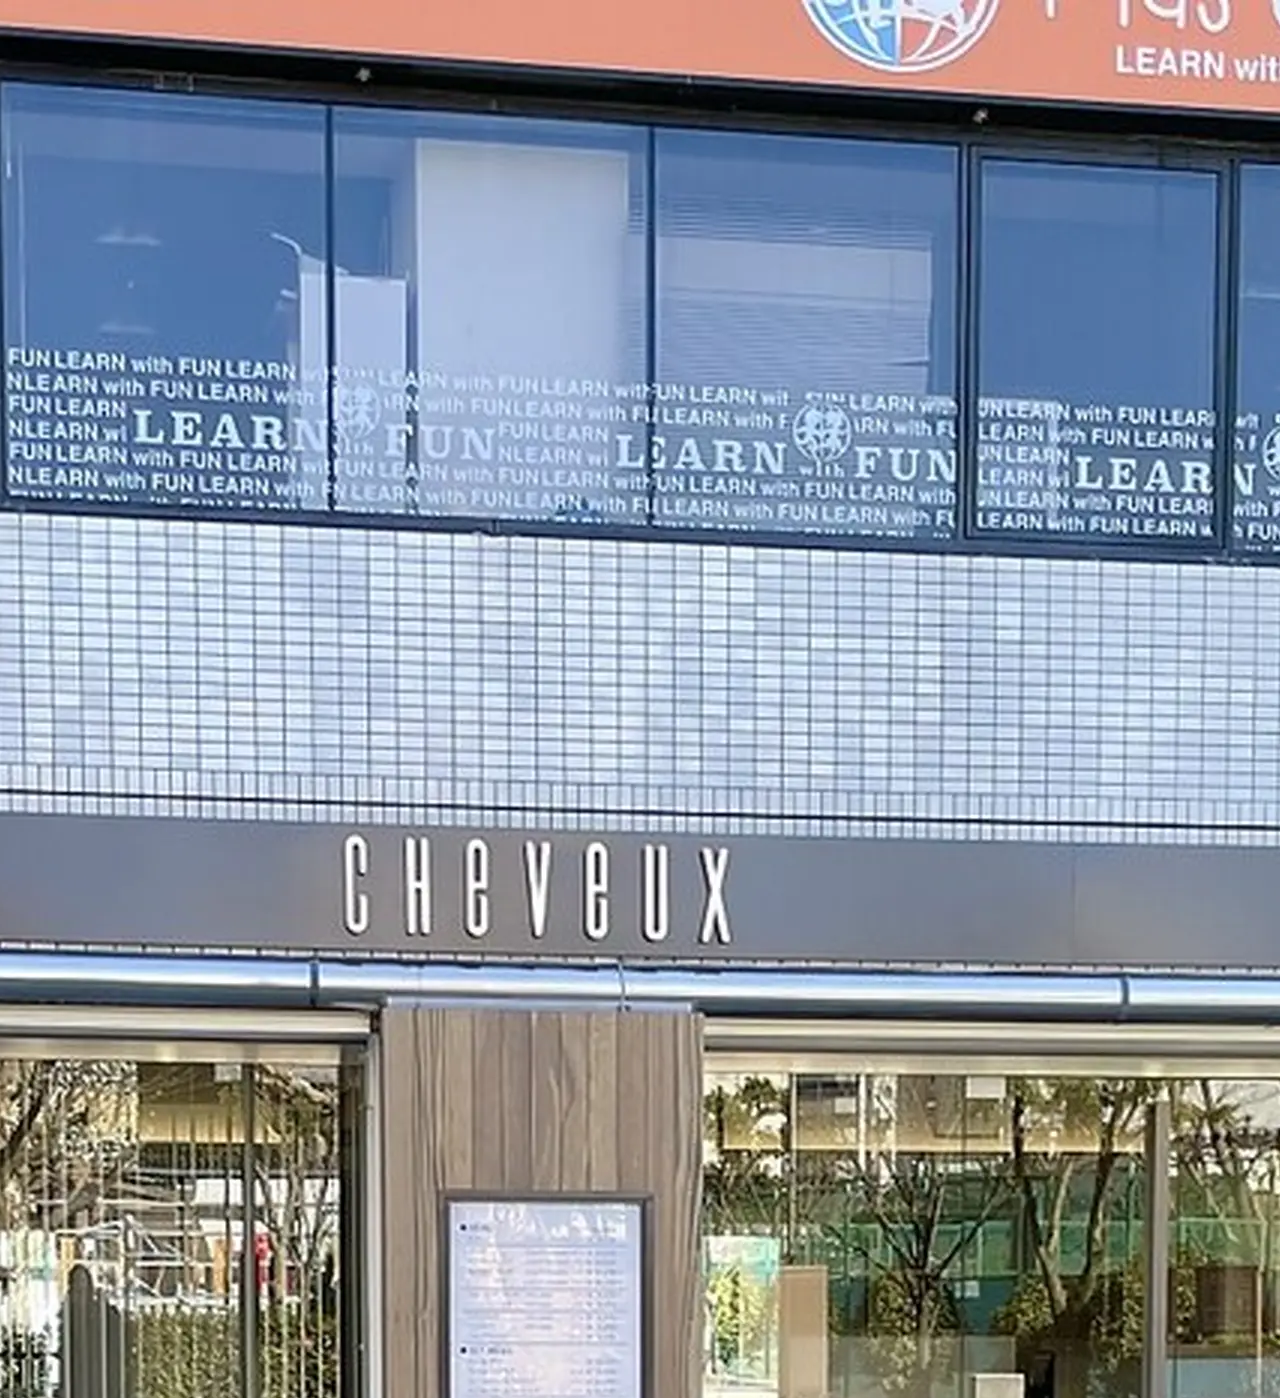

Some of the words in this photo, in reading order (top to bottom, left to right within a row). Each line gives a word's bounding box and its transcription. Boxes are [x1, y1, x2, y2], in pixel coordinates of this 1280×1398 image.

[1116, 45, 1224, 80] LEARN
[9, 348, 50, 367] FUN
[55, 351, 125, 372] LEARN
[131, 356, 173, 374] with
[180, 357, 220, 376] FUN
[225, 360, 296, 380] LEARN
[24, 374, 97, 394] LEARN
[102, 378, 145, 396] with
[151, 381, 192, 399] FUN
[198, 383, 268, 402] LEARN
[690, 386, 756, 405] LEARN
[850, 393, 914, 412] LEARN
[9, 395, 51, 413] FUN
[55, 398, 126, 418] LEARN
[664, 408, 729, 427] LEARN
[1007, 401, 1069, 420] LEARN
[1075, 405, 1112, 422] with
[1119, 407, 1157, 424] FUN
[25, 421, 98, 441] LEARN
[133, 410, 327, 451] LEARN
[979, 422, 1043, 442] LEARN
[1093, 428, 1130, 445] FUN
[1135, 431, 1197, 449] LEARN
[9, 441, 51, 461] FUN
[56, 444, 127, 464] LEARN
[132, 450, 174, 467] with
[181, 452, 220, 469] FUN
[228, 453, 296, 473] LEARN
[616, 435, 787, 474] LEARN
[854, 447, 956, 482] FUN
[25, 468, 98, 487] LEARN
[104, 472, 146, 489] with
[152, 474, 194, 492] FUN
[199, 476, 268, 495] LEARN
[979, 465, 1043, 485] LEARN
[1075, 456, 1212, 493] LEAR
[690, 476, 755, 495] LEARN
[805, 482, 843, 499] FUN
[849, 483, 914, 501] LEARN
[919, 489, 956, 504] with
[779, 504, 818, 521] FUN
[822, 505, 887, 524] LEARN
[1117, 495, 1154, 513] FUN
[978, 512, 1043, 530] LEARN
[1089, 518, 1127, 534] FUN
[1133, 519, 1195, 536] LEARN
